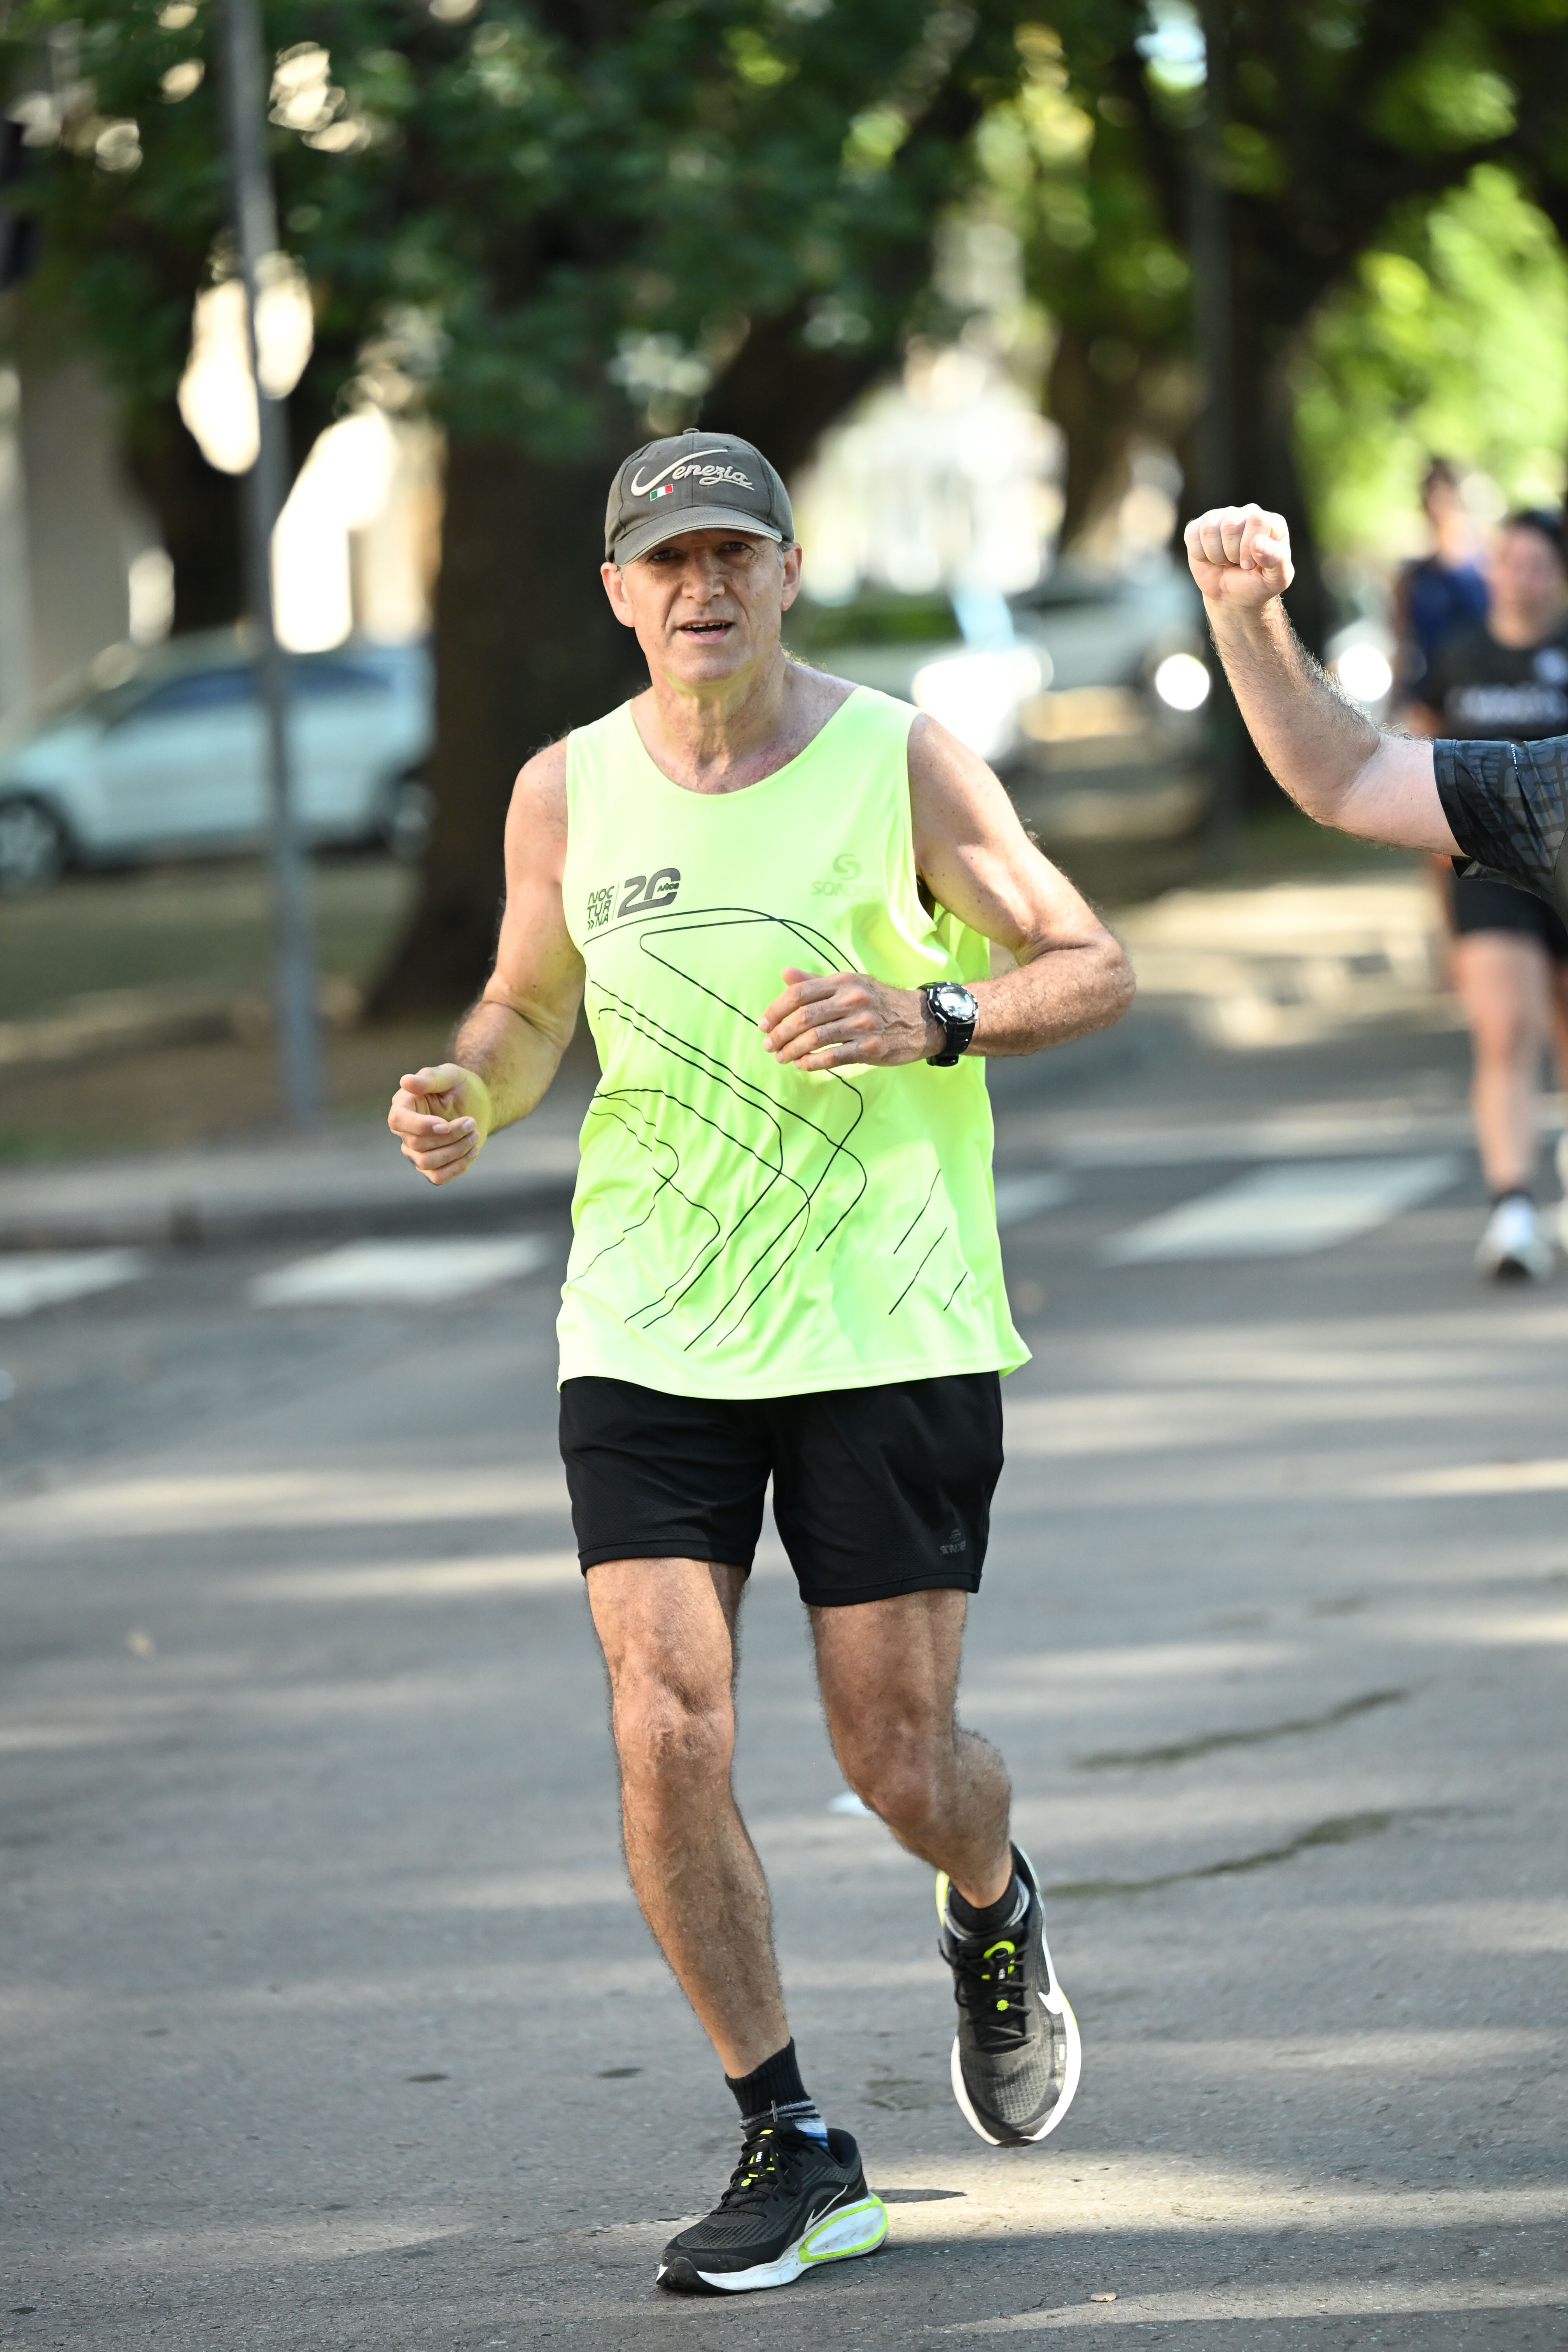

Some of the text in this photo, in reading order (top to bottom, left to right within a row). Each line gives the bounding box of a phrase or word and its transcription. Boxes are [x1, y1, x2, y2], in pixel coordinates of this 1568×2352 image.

[630, 449, 754, 497] Venezia
[588, 886, 614, 905] NOC
[587, 900, 611, 919] TUR
